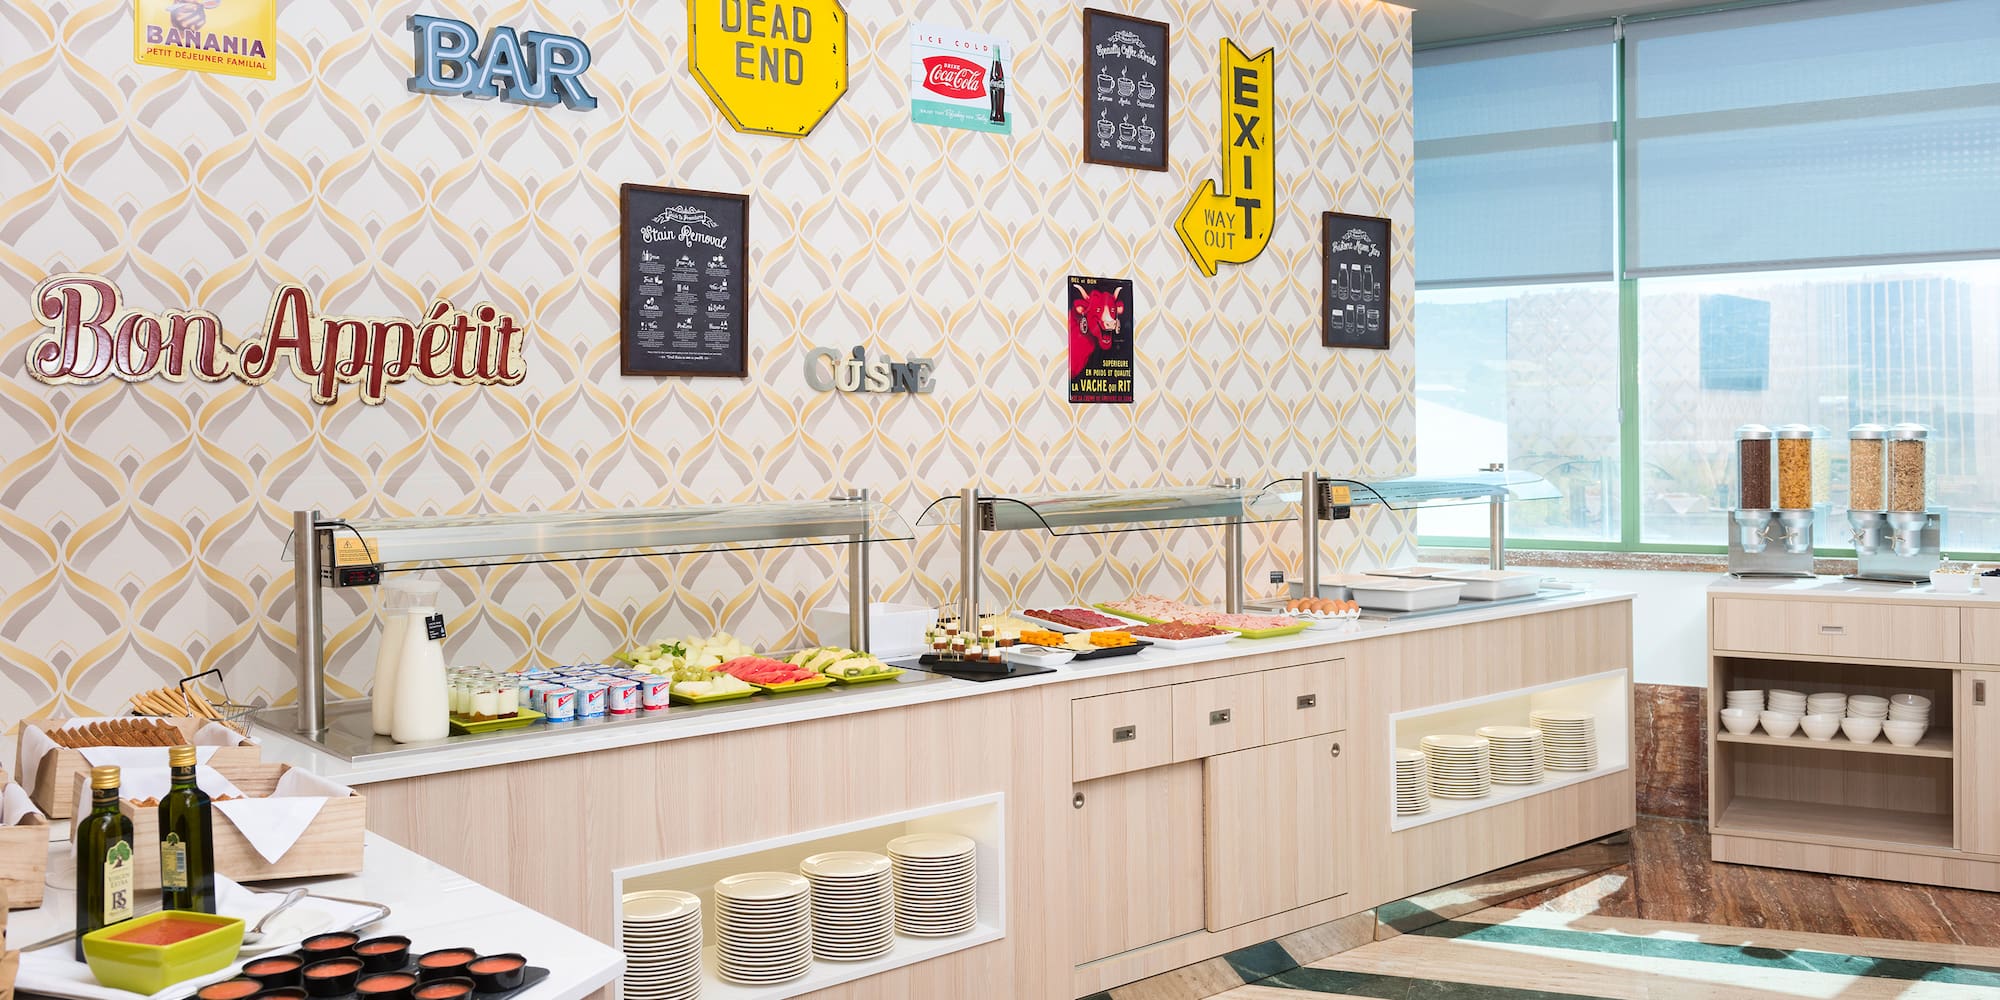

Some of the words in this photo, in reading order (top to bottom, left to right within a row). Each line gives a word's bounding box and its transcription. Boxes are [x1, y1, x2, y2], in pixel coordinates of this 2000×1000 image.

[721, 0, 812, 44] DEAD
[146, 24, 267, 59] BANANIA
[919, 34, 943, 45] ICE
[954, 40, 989, 52] COLD
[146, 47, 172, 57] PETIT
[175, 51, 224, 64] DÉJEUNER
[226, 57, 267, 70] FAMILIAL
[406, 14, 598, 112] BAR
[735, 41, 804, 86] END
[1233, 66, 1261, 240] EXIT
[1204, 208, 1236, 230] WAY
[640, 225, 676, 244] Stain
[678, 224, 728, 250] Removal
[1204, 229, 1236, 250] OUT
[36, 277, 230, 379] Bon
[243, 285, 521, 400] Appétit
[1071, 383, 1079, 392] LA
[1080, 379, 1107, 392] VACHE
[1117, 379, 1132, 392] RIT
